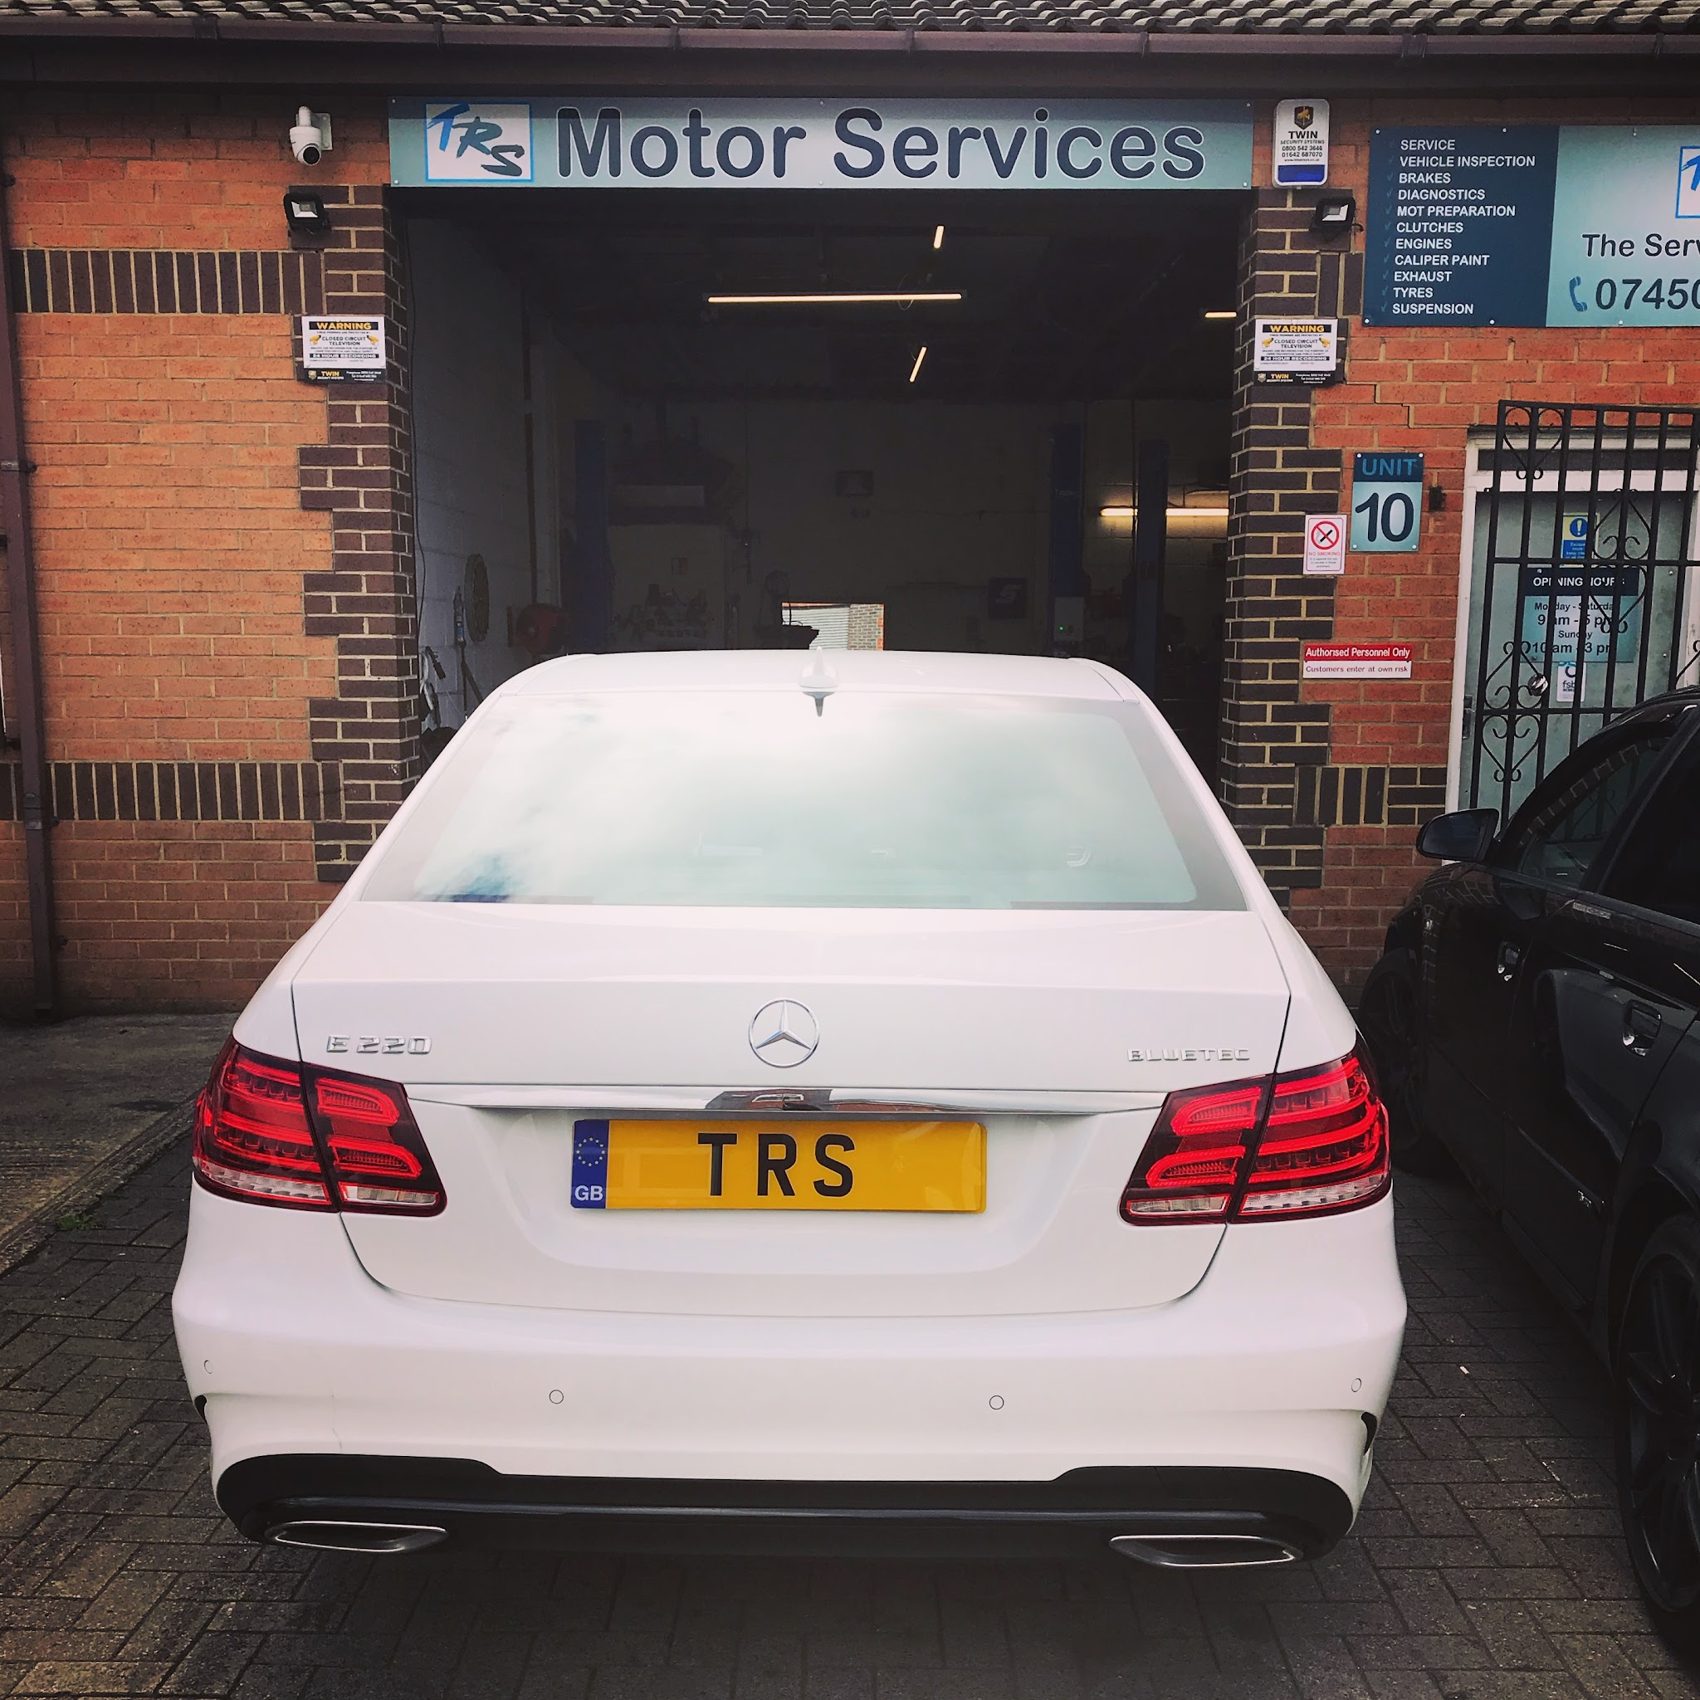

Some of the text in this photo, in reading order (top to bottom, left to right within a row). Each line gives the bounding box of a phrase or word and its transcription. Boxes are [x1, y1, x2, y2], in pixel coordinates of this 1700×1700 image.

[426, 103, 525, 177] TRS
[1288, 130, 1318, 139] TWIN
[557, 106, 1205, 179] Motor Services
[1400, 139, 1456, 151] SERVICE
[1399, 156, 1536, 167] VEHICLE INSPECTION
[1399, 173, 1451, 184] BRAKES
[1398, 189, 1486, 200] DIAGNOSTICS
[1397, 206, 1516, 217] MOT PREPARATION
[1396, 222, 1464, 233] CLUTCHES
[1395, 239, 1452, 249] ENGINES
[1582, 233, 1700, 257] The Ser
[1394, 255, 1490, 266] CALIPER PAINT
[1394, 271, 1452, 282] EXHAUST
[1393, 287, 1433, 298] TYRES
[1392, 304, 1474, 315] SUSPENSION
[1362, 459, 1418, 475] UNIT
[1355, 493, 1414, 542] 10
[1535, 603, 1570, 612] Moday
[1538, 614, 1545, 625] 9
[1552, 644, 1572, 653] am
[1585, 642, 1592, 653] 3
[1306, 648, 1410, 659] Authorised Personnel Only
[326, 1036, 432, 1055] E 220
[1127, 1048, 1250, 1061] BLUETEC
[698, 1132, 856, 1198] TRS
[574, 1185, 604, 1201] GB
